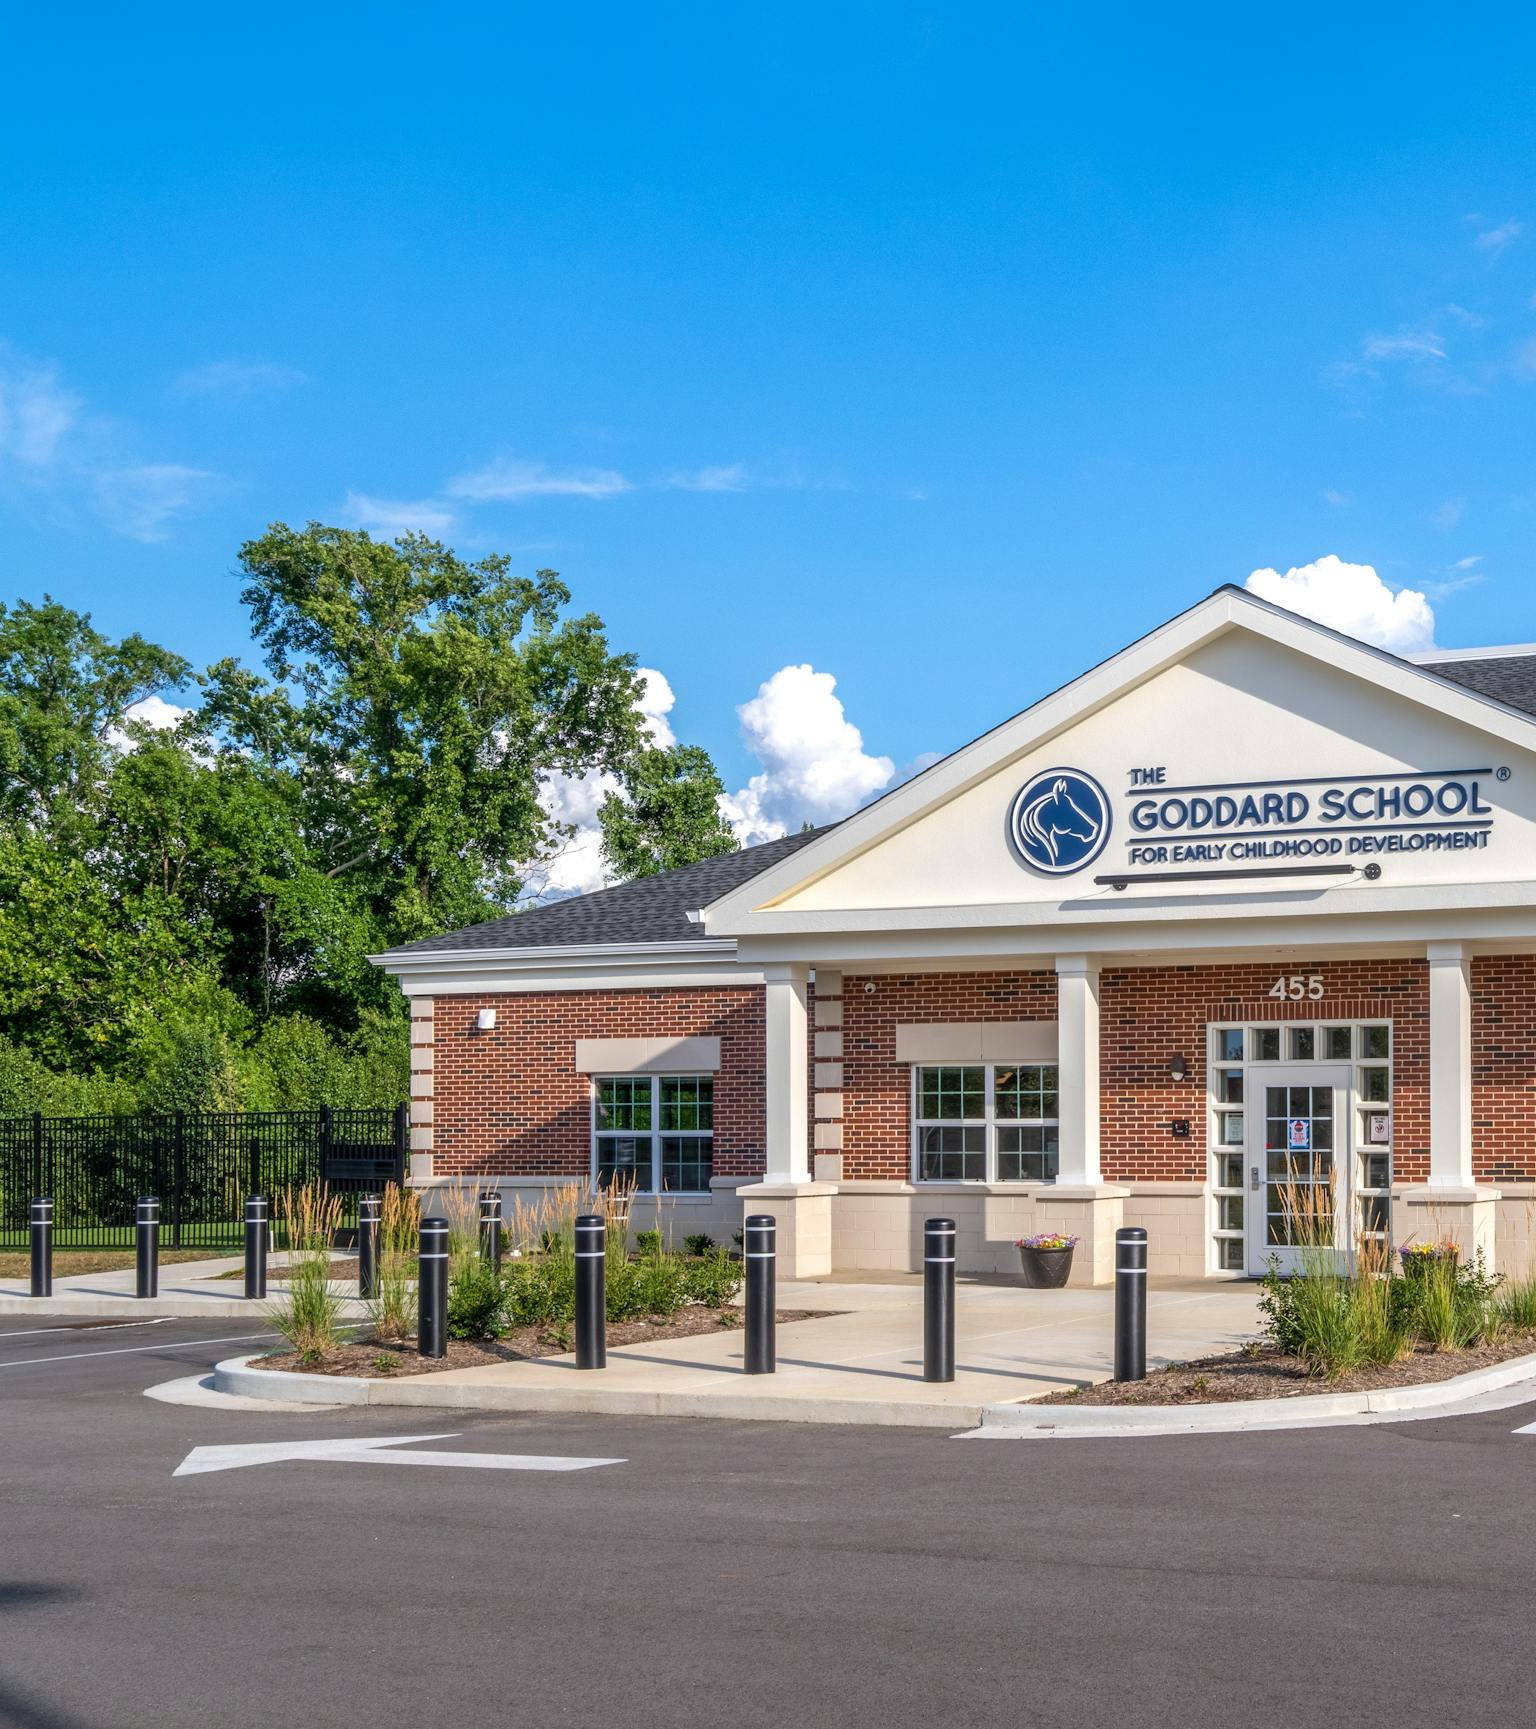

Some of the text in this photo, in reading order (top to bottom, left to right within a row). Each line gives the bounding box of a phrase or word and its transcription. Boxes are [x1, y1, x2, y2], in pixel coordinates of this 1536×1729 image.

[1130, 766, 1166, 784] THE
[1132, 781, 1492, 831] GODDARD SCHOOL
[1131, 830, 1492, 864] FOR EARLY CHILDHOOD DEVELOPMENT
[1268, 975, 1325, 1001] 455
